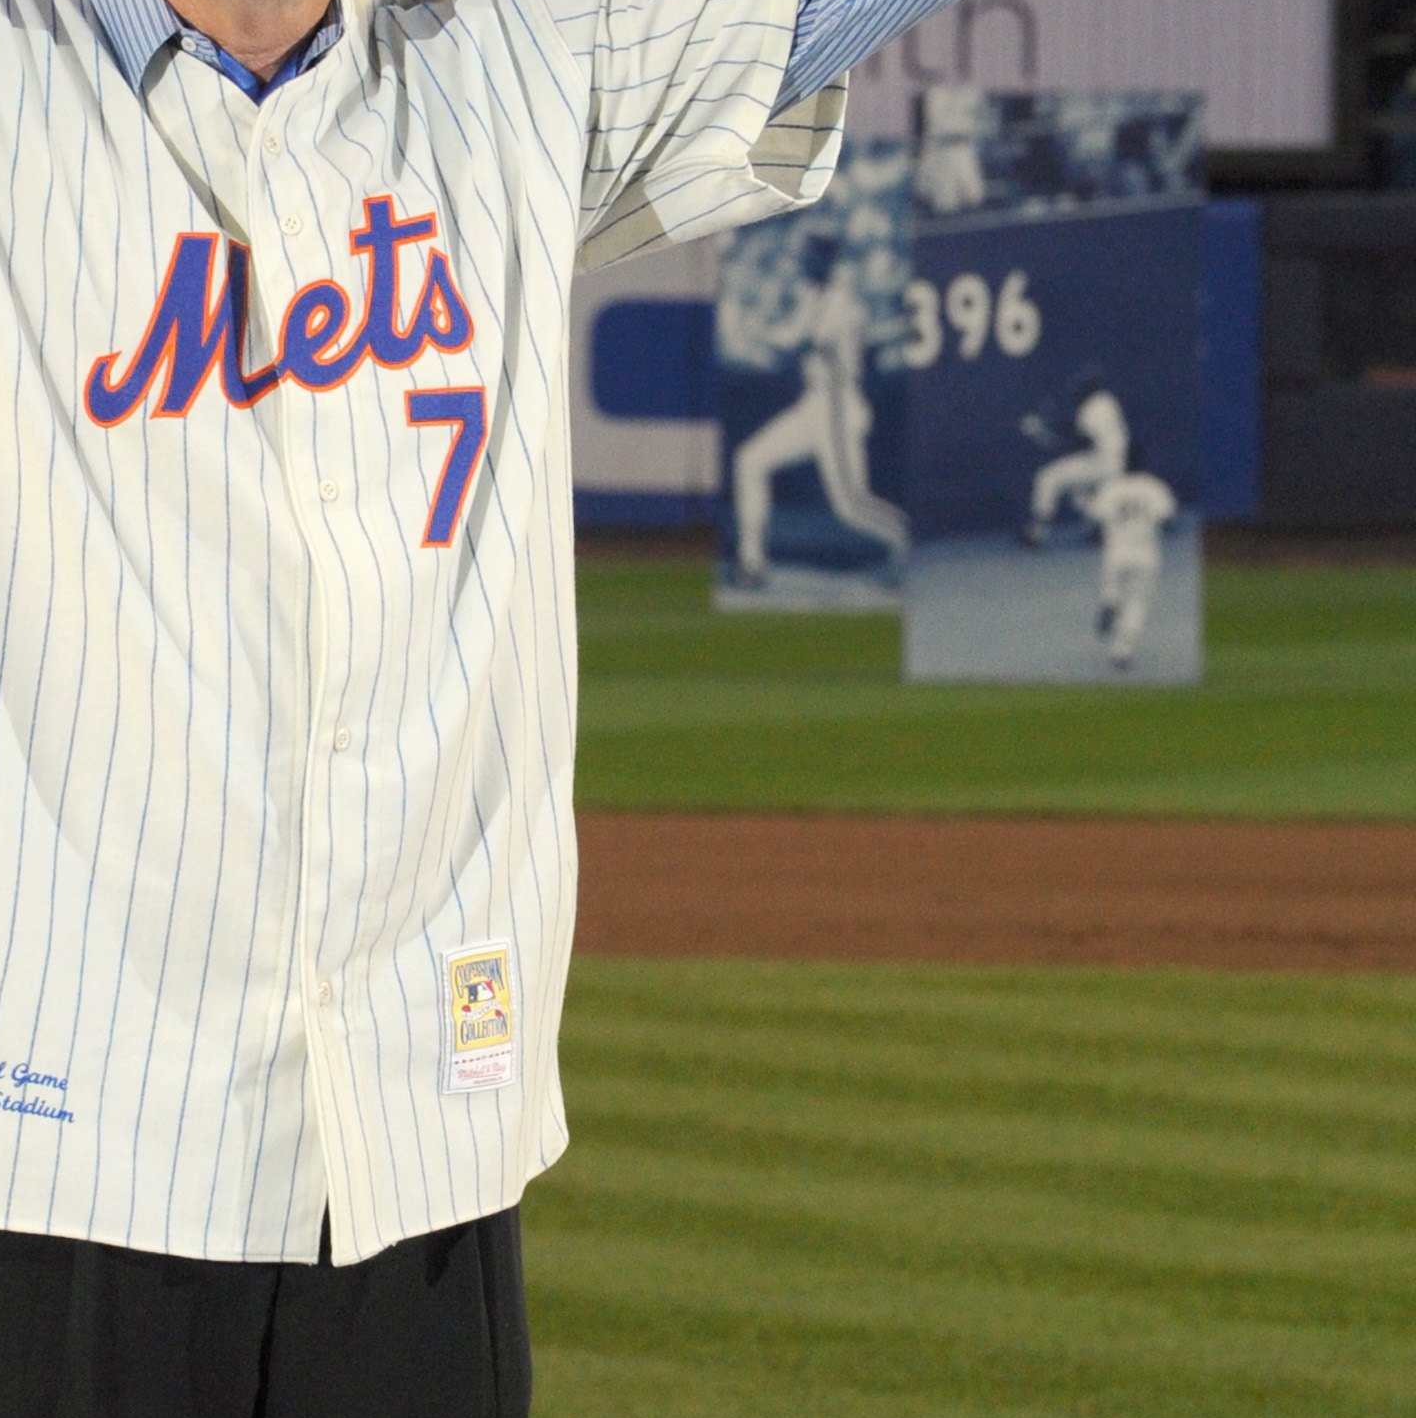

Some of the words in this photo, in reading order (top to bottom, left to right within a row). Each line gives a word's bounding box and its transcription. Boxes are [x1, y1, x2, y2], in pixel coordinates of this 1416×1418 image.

[84, 194, 474, 428] Mets
[901, 268, 1042, 369] 396
[404, 386, 486, 548] 7
[11, 1063, 68, 1091] Game
